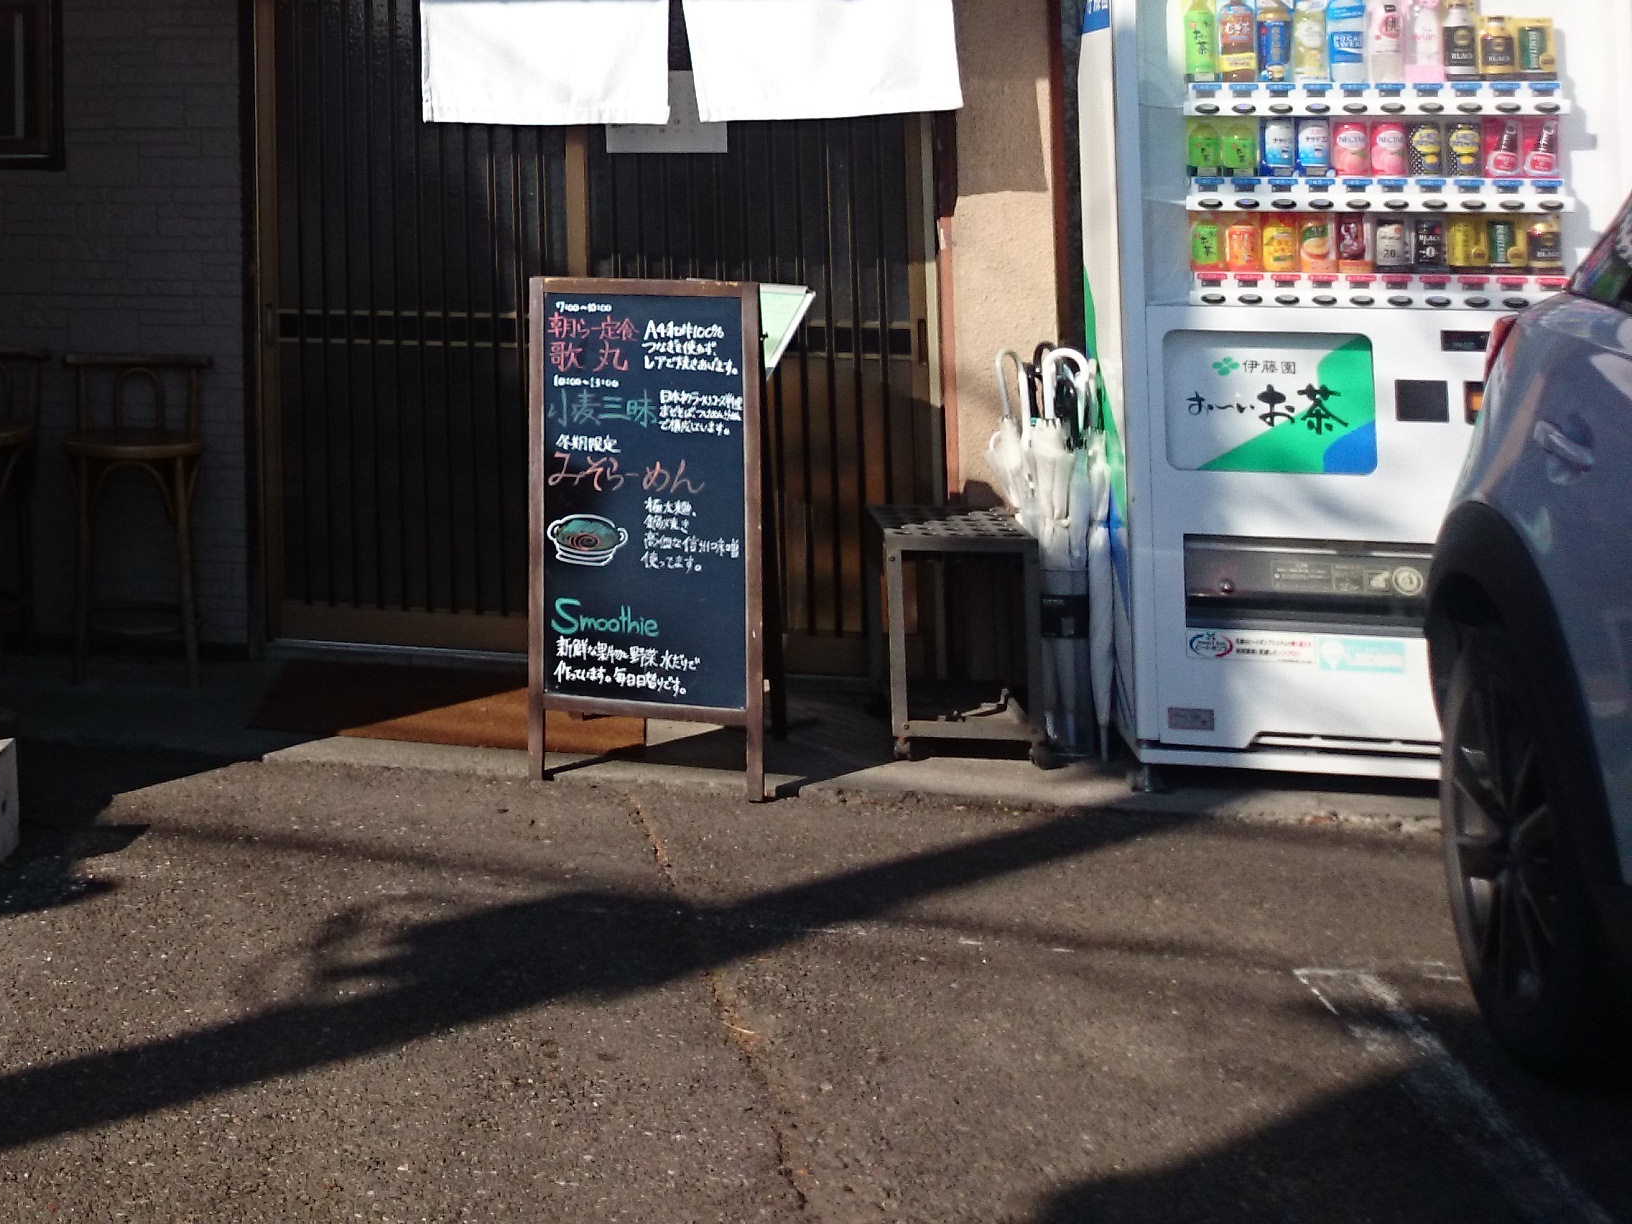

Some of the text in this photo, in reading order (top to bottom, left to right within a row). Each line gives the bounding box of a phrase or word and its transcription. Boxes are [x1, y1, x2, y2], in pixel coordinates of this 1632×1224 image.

[1243, 359, 1297, 374] 伊藤園
[548, 451, 705, 492] みそらーめん
[551, 596, 660, 637] Smoothie
